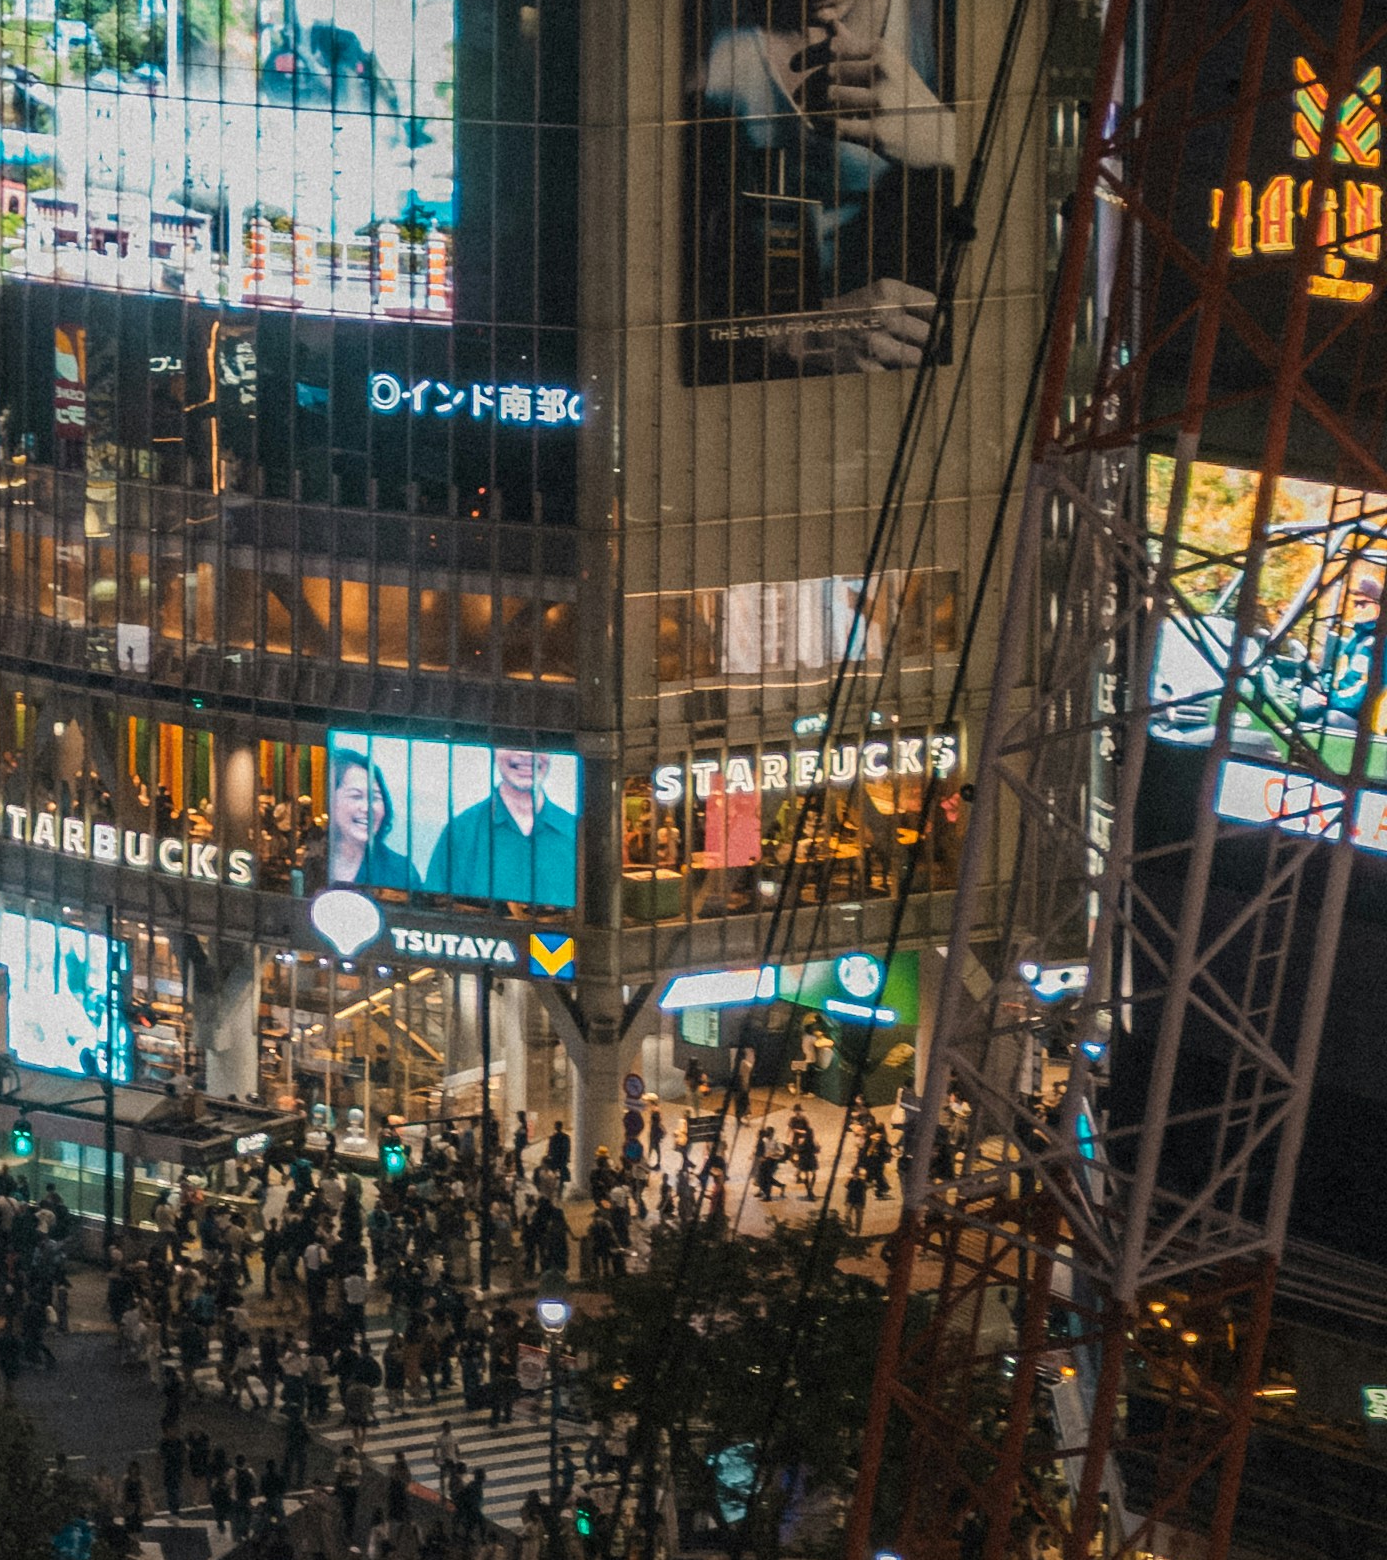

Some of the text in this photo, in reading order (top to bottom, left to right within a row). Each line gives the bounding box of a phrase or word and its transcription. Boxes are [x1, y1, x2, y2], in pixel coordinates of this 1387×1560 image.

[709, 328, 738, 341] THE
[744, 325, 779, 339] NEW
[655, 736, 956, 803] STARBUCKS
[391, 927, 515, 962] TSUTAYA
